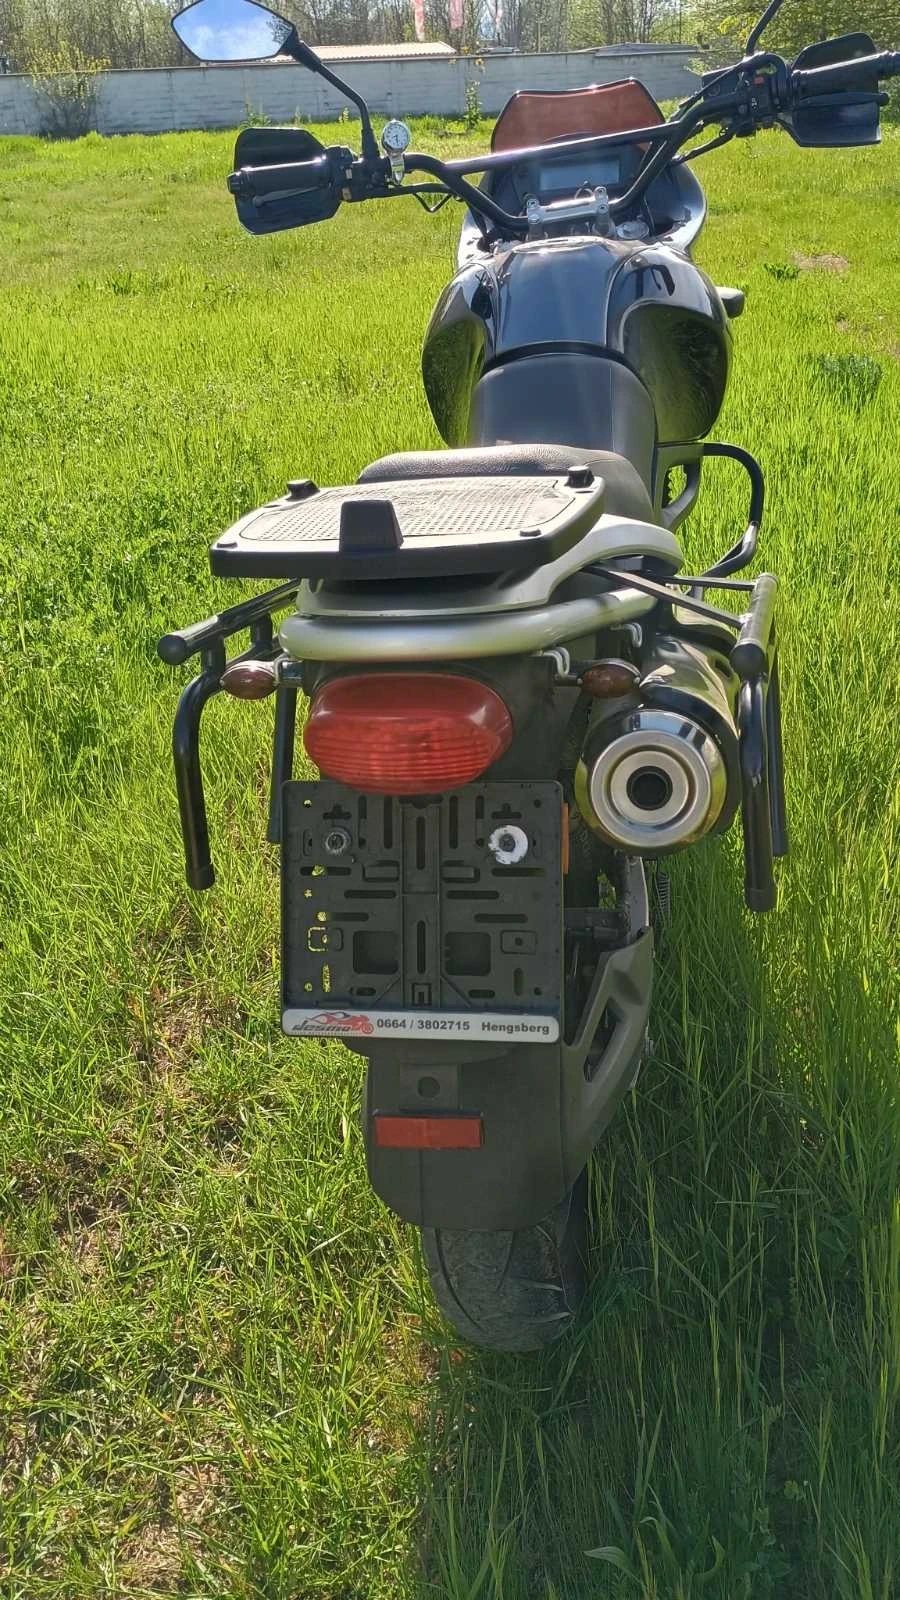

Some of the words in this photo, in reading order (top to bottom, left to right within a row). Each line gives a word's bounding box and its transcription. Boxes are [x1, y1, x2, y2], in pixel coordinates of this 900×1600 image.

[376, 1018, 406, 1029] 0664
[417, 1020, 470, 1031] 3802715
[481, 1021, 550, 1035] Hengsberg
